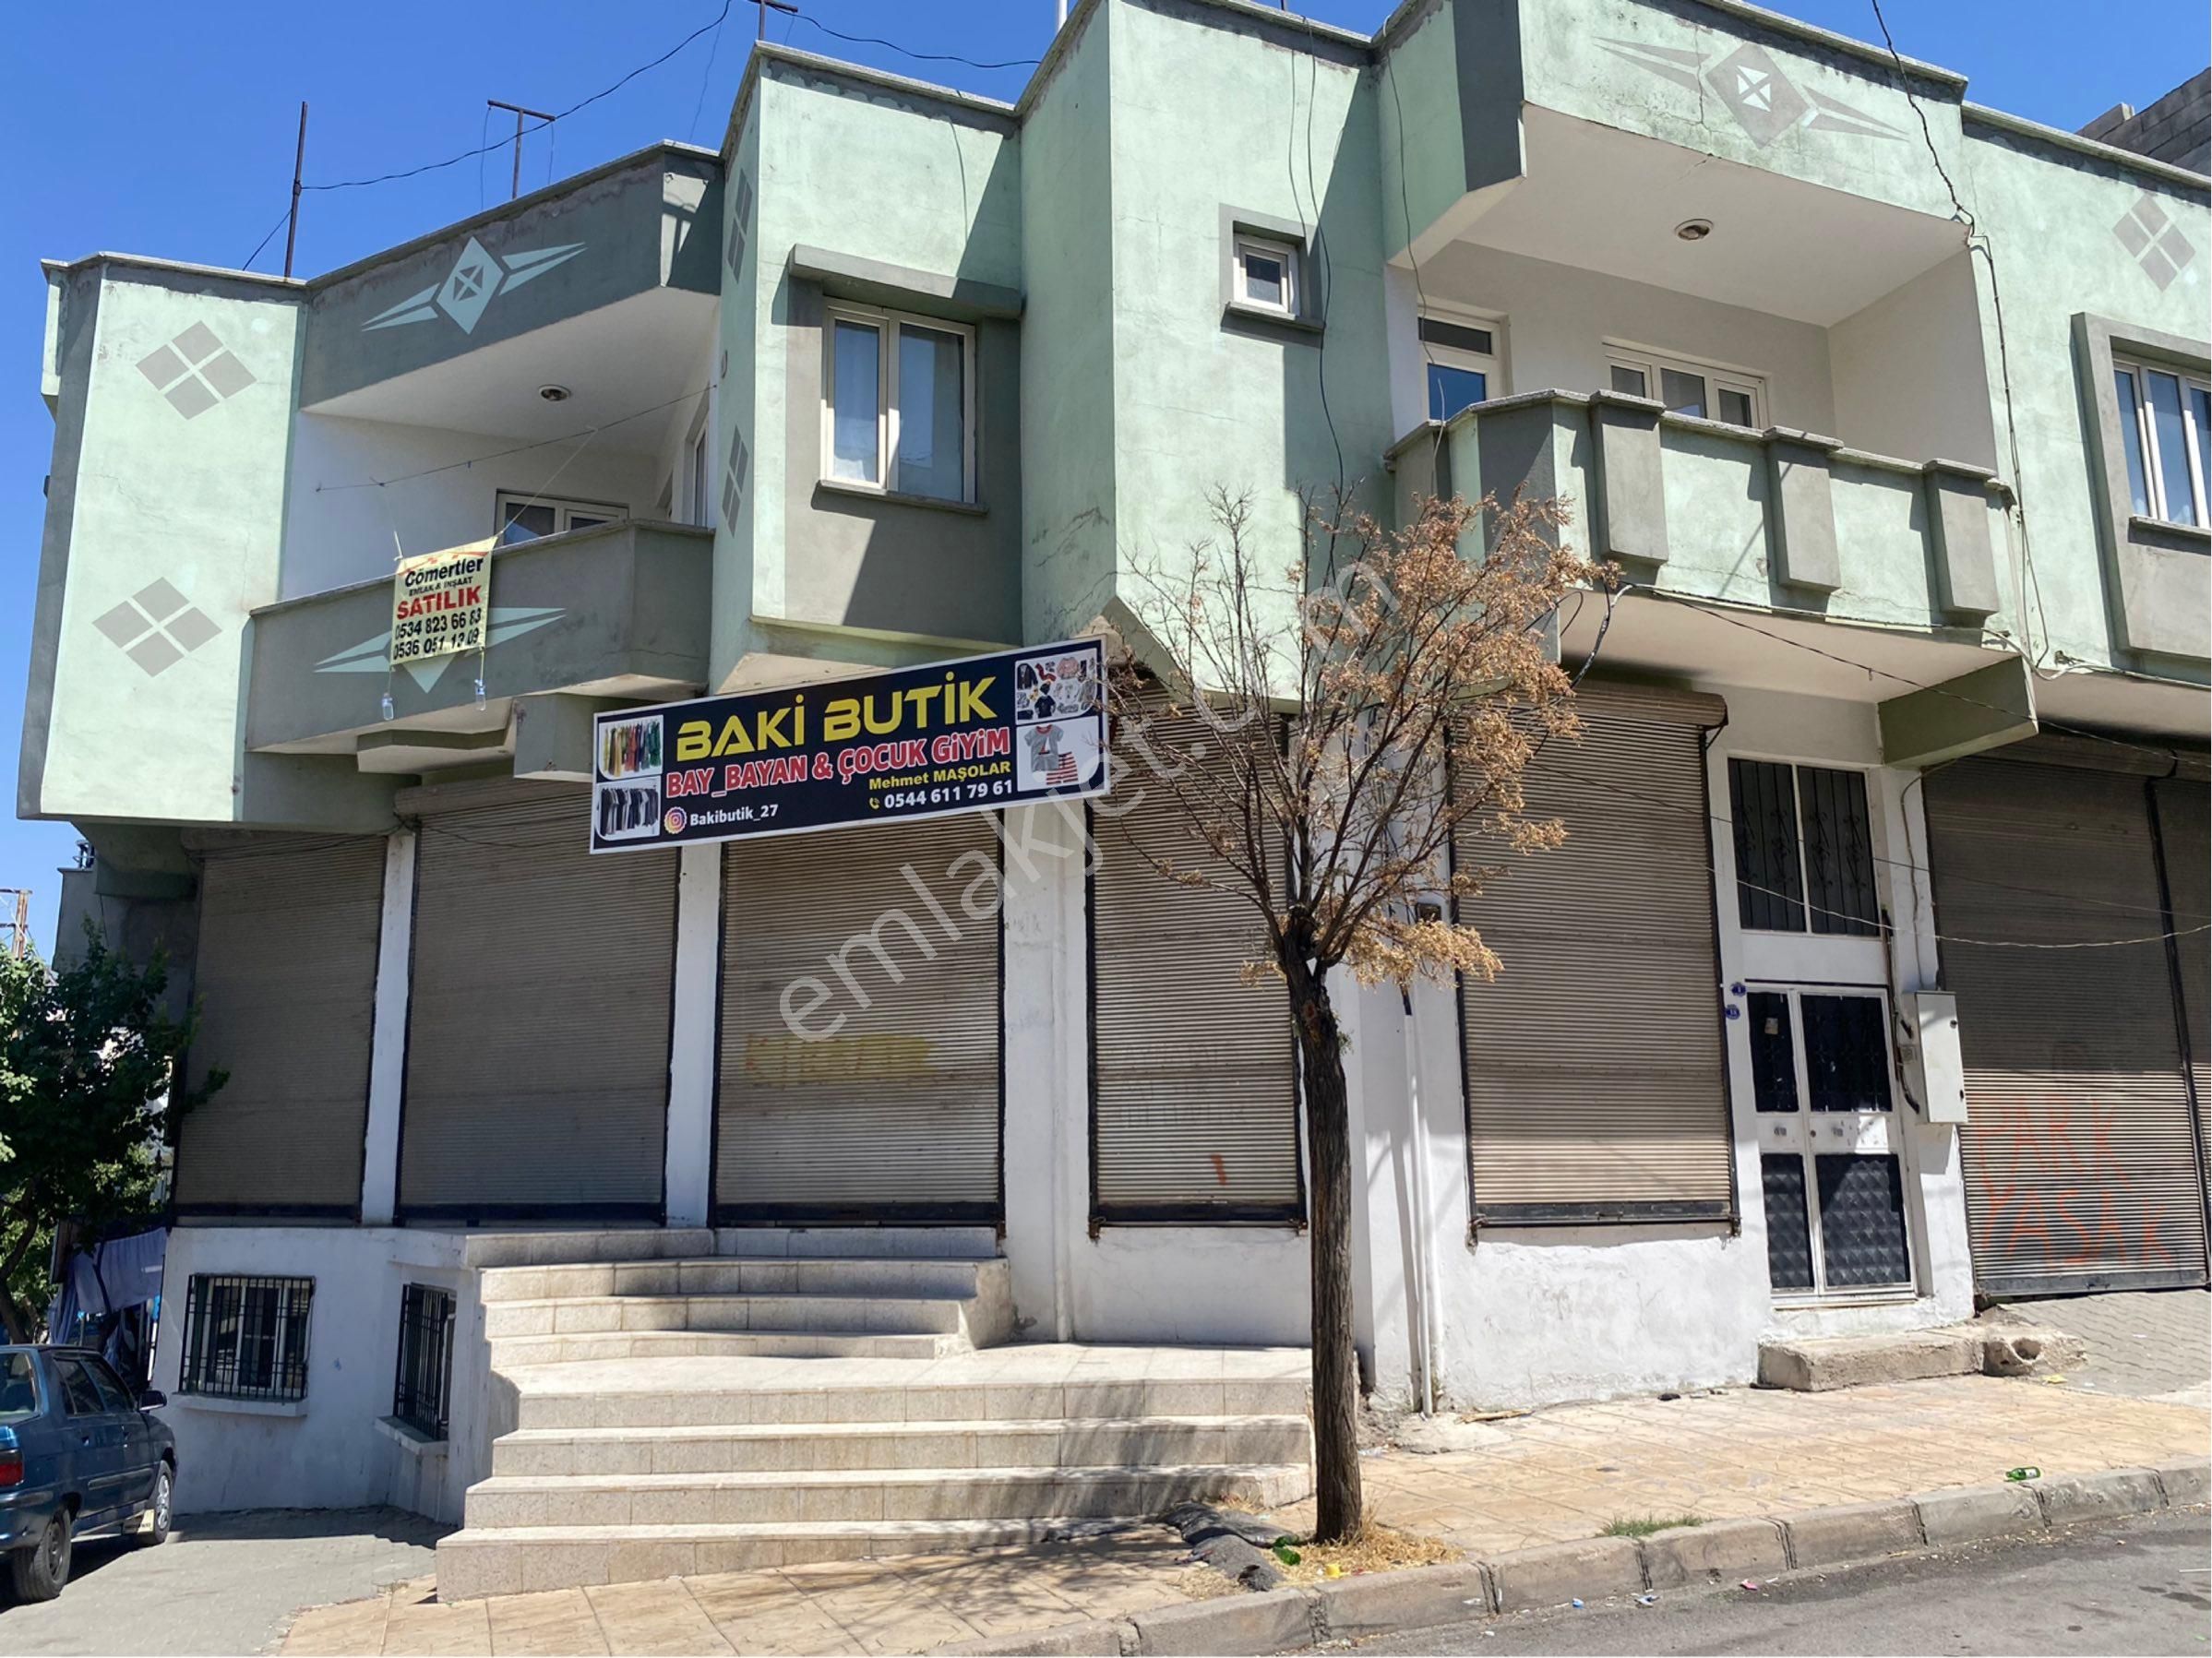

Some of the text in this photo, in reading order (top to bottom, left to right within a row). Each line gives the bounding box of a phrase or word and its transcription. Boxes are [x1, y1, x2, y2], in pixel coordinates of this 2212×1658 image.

[404, 558, 484, 587] Cömertler
[397, 586, 482, 619] SATILIK
[395, 619, 422, 640] 0534
[425, 614, 448, 634] 823
[451, 612, 466, 630] 66
[393, 639, 420, 661] 0536
[676, 671, 998, 761] BAKİ BUTİK
[812, 752, 833, 780] &
[837, 738, 927, 784] ÇOCUK
[869, 761, 1011, 791] Mehmet MAŞOLAR
[884, 780, 1012, 808] 0544 611 79 61
[689, 804, 779, 826] Bakibutik_27
